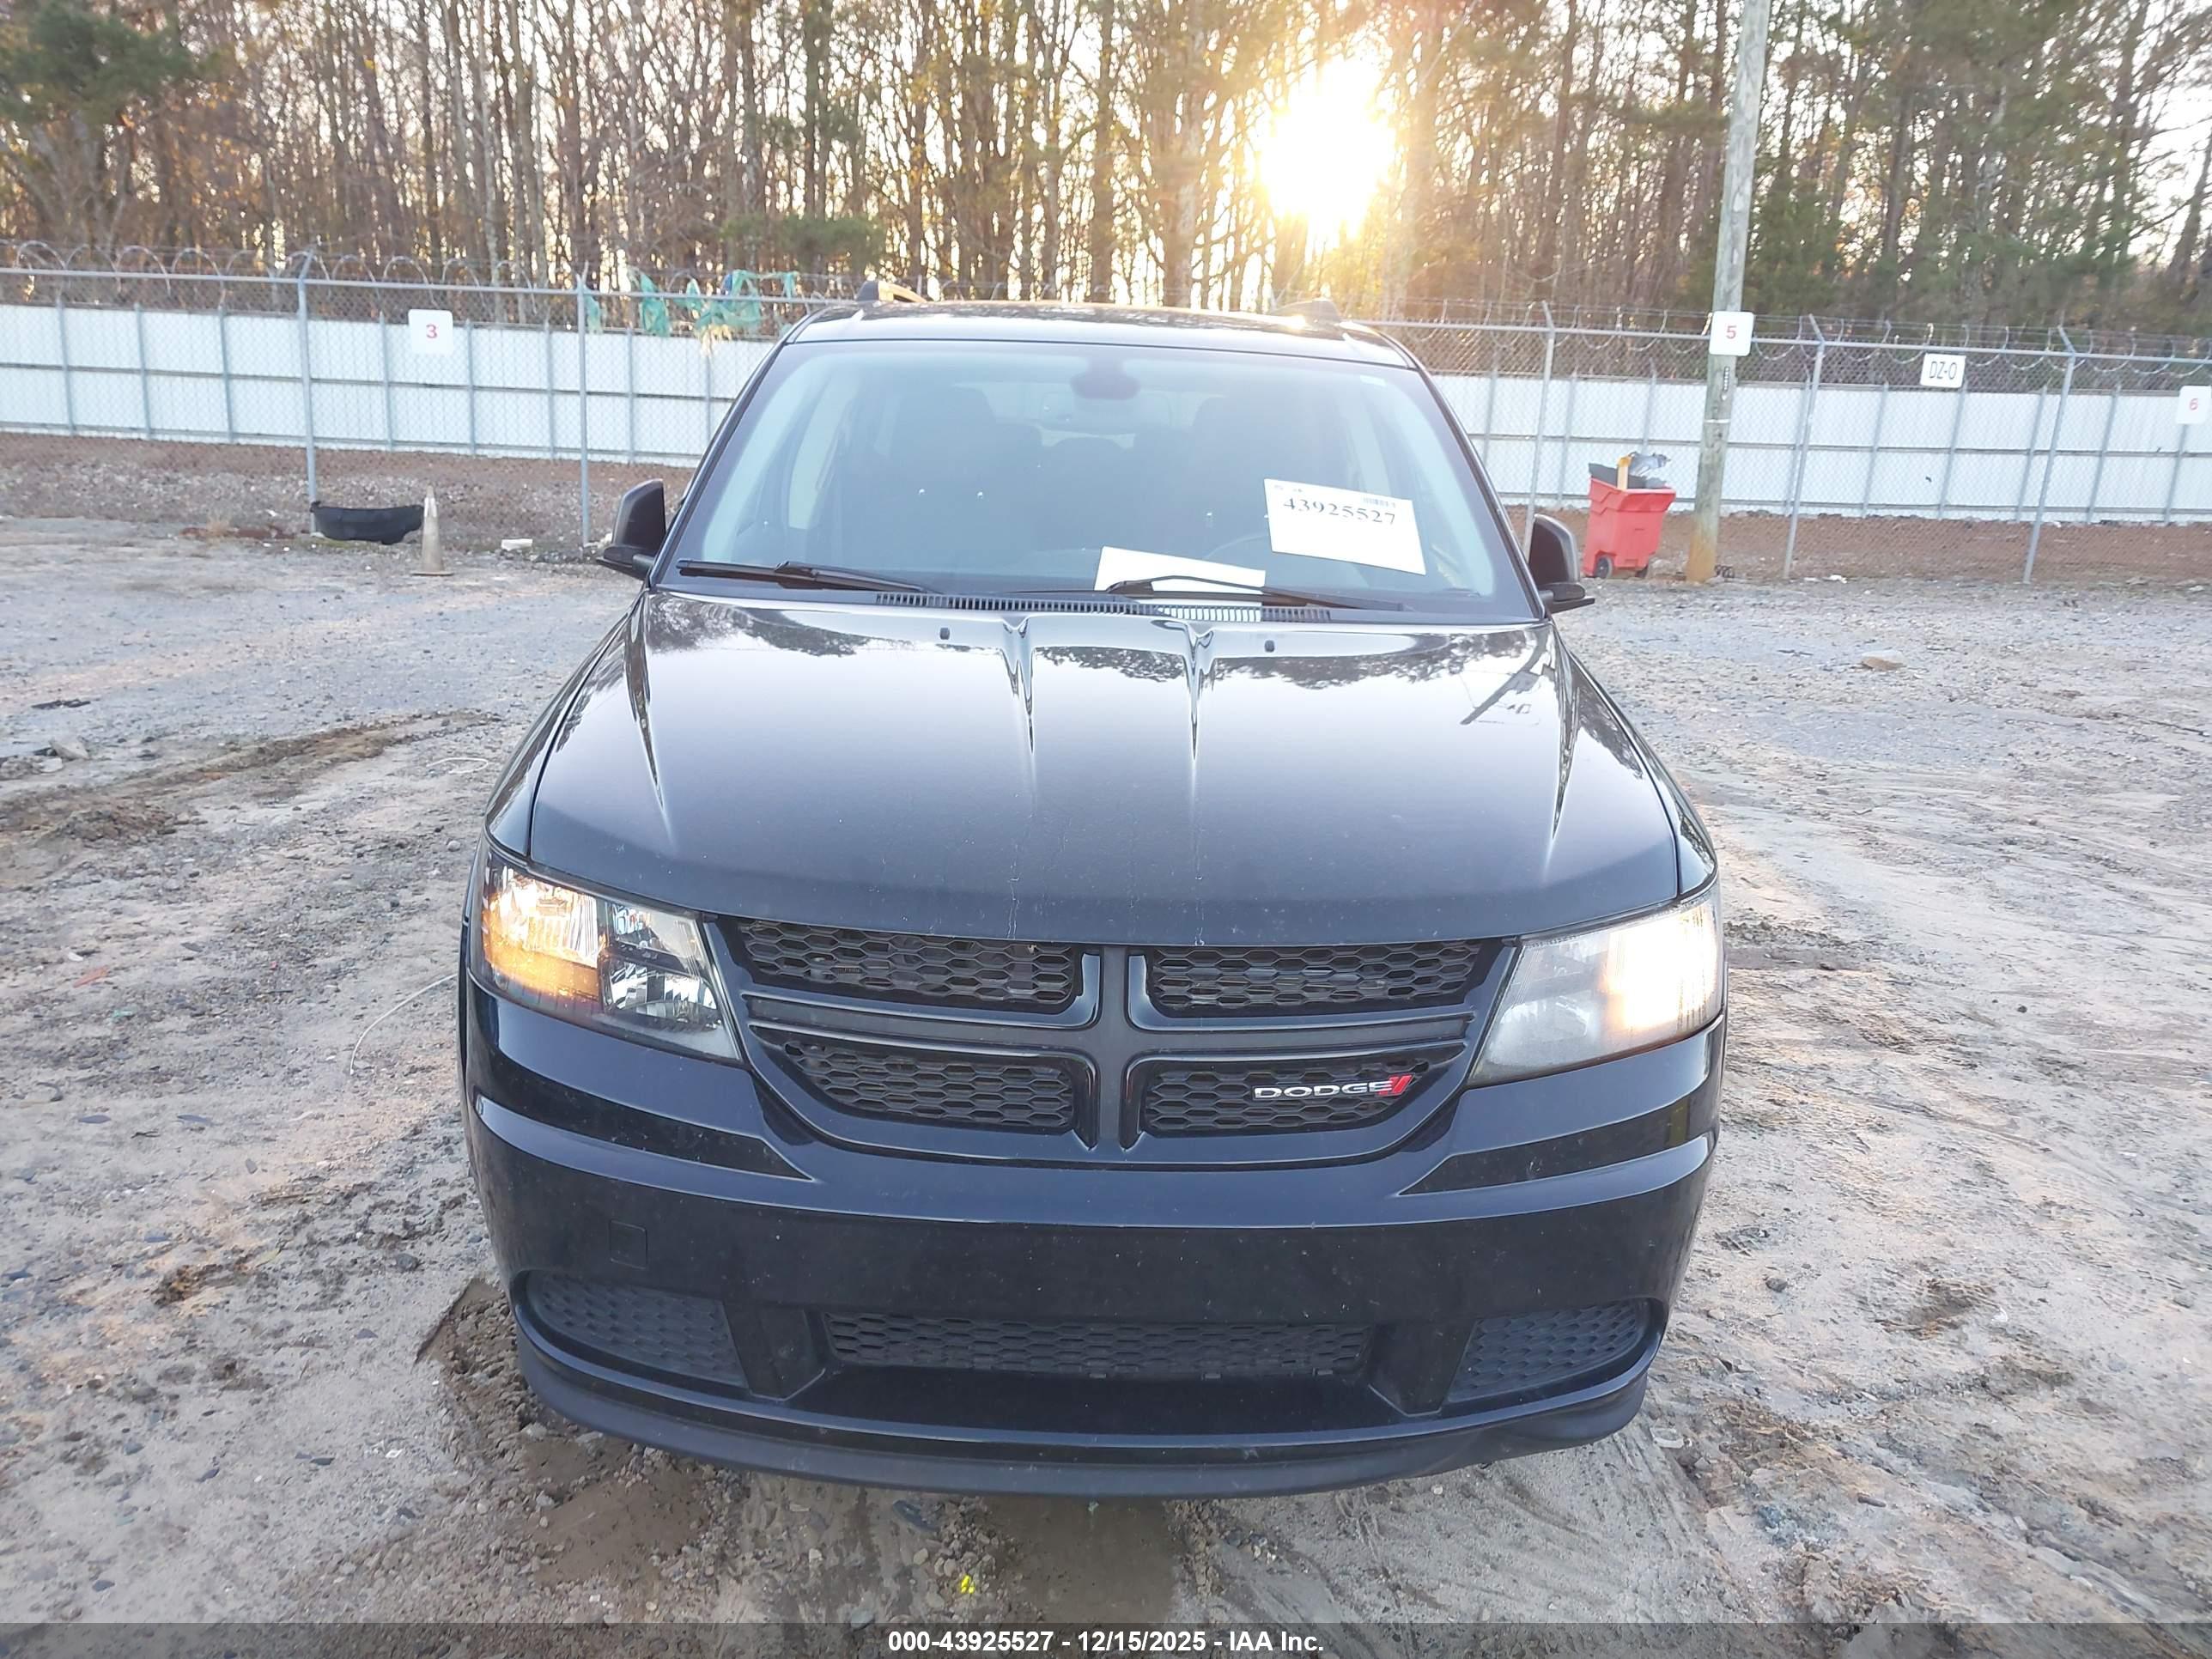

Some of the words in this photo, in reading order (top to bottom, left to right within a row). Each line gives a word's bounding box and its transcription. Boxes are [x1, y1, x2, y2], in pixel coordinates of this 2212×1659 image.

[426, 324, 438, 338] 3
[1726, 325, 1737, 340] 5
[1284, 497, 1395, 526] 43925527
[1254, 1080, 1393, 1099] DODGE
